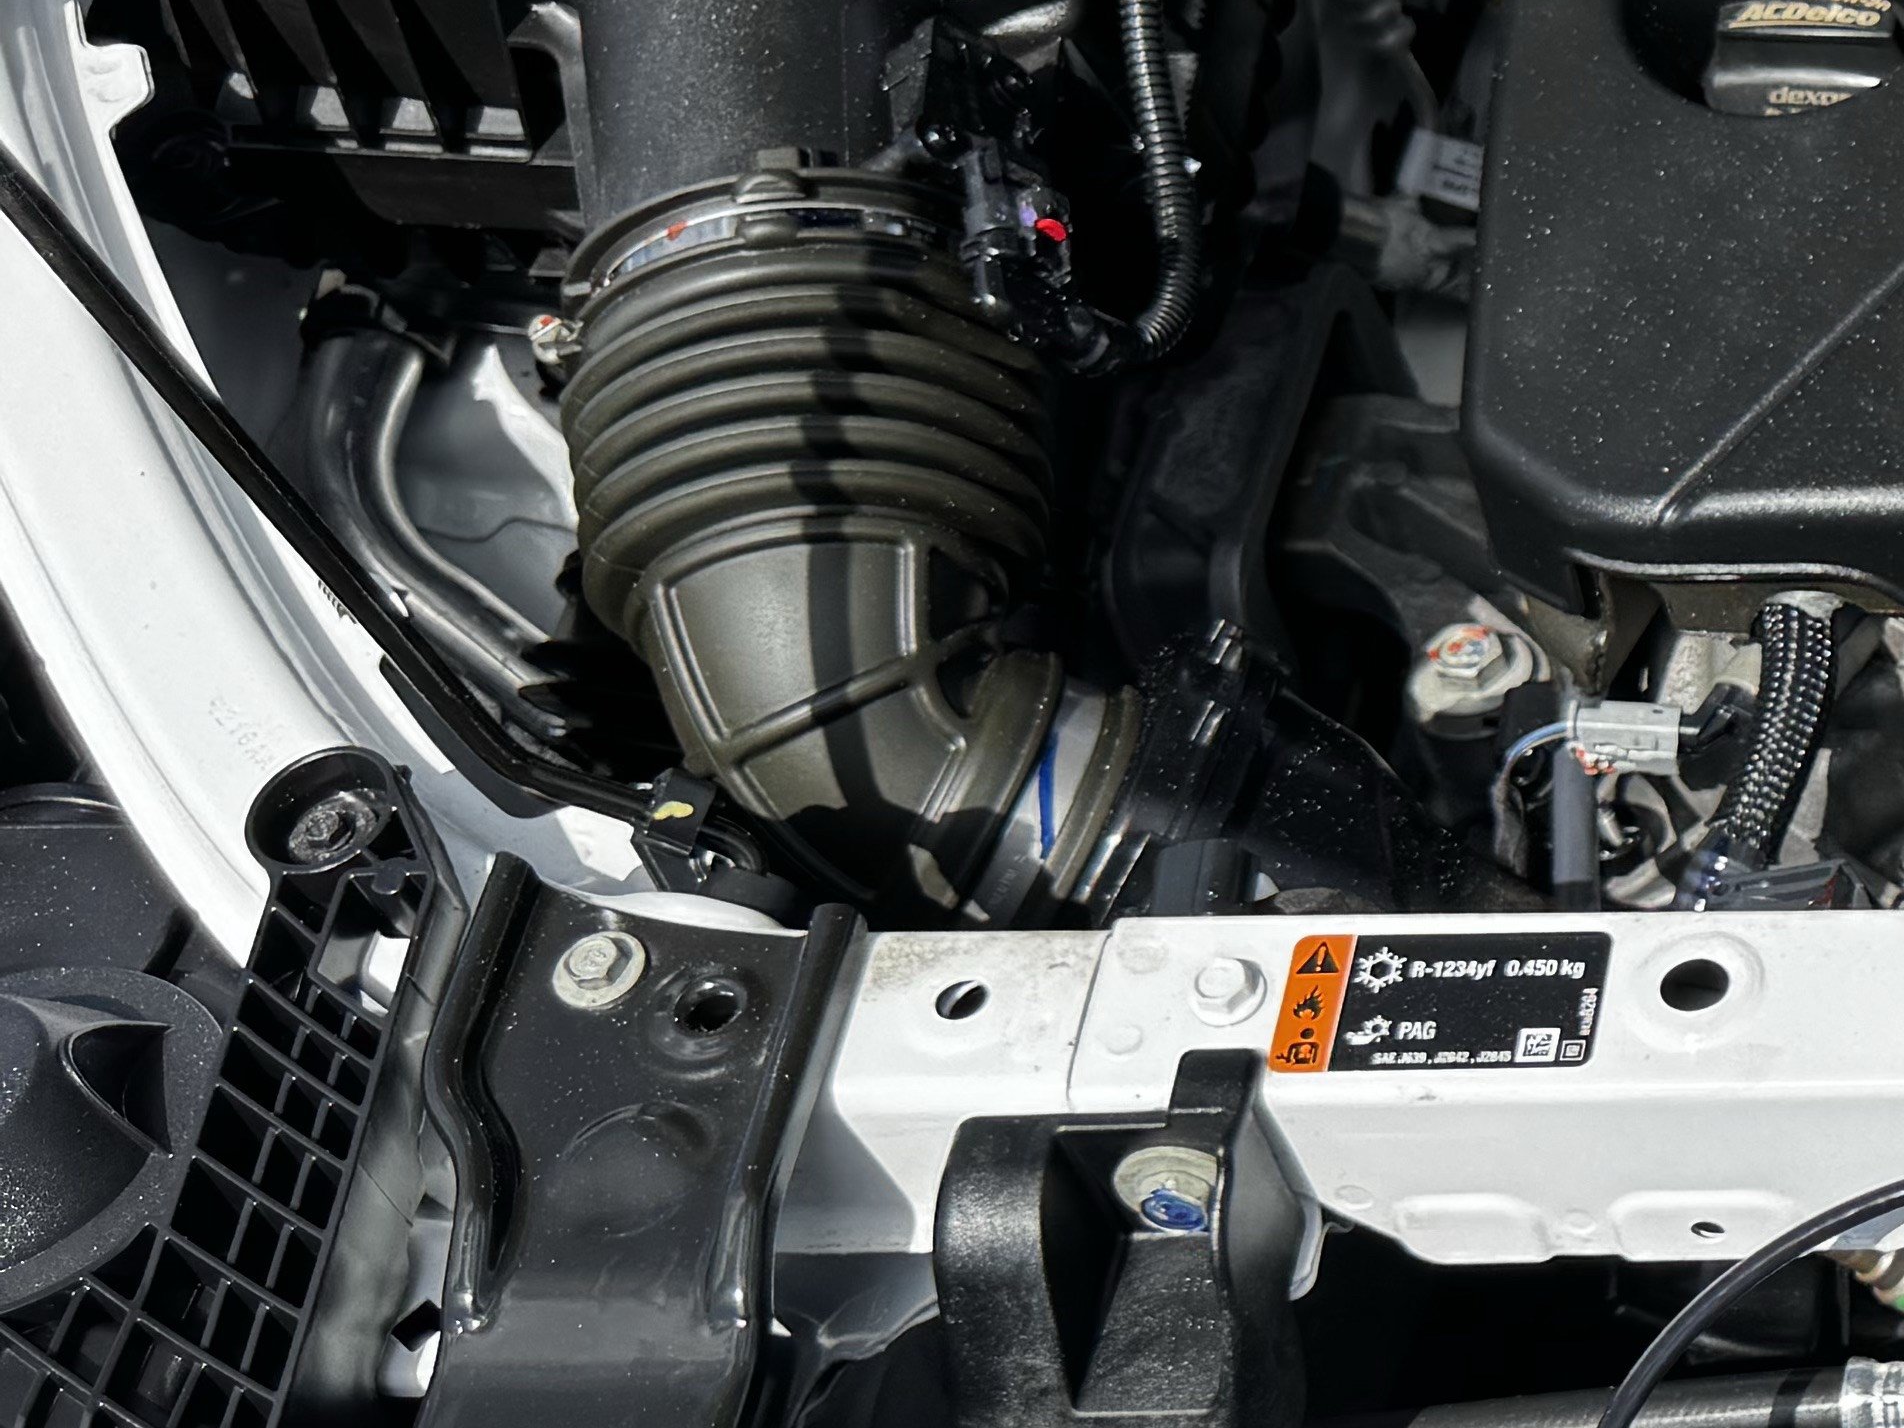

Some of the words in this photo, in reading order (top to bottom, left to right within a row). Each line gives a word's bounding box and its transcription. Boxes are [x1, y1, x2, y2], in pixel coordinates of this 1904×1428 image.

[1729, 2, 1880, 26] ACDelco
[1409, 960, 1497, 981] R-1234yf
[1504, 960, 1557, 976] 0.450
[1559, 960, 1585, 979] kg
[1395, 1021, 1436, 1040] PAG
